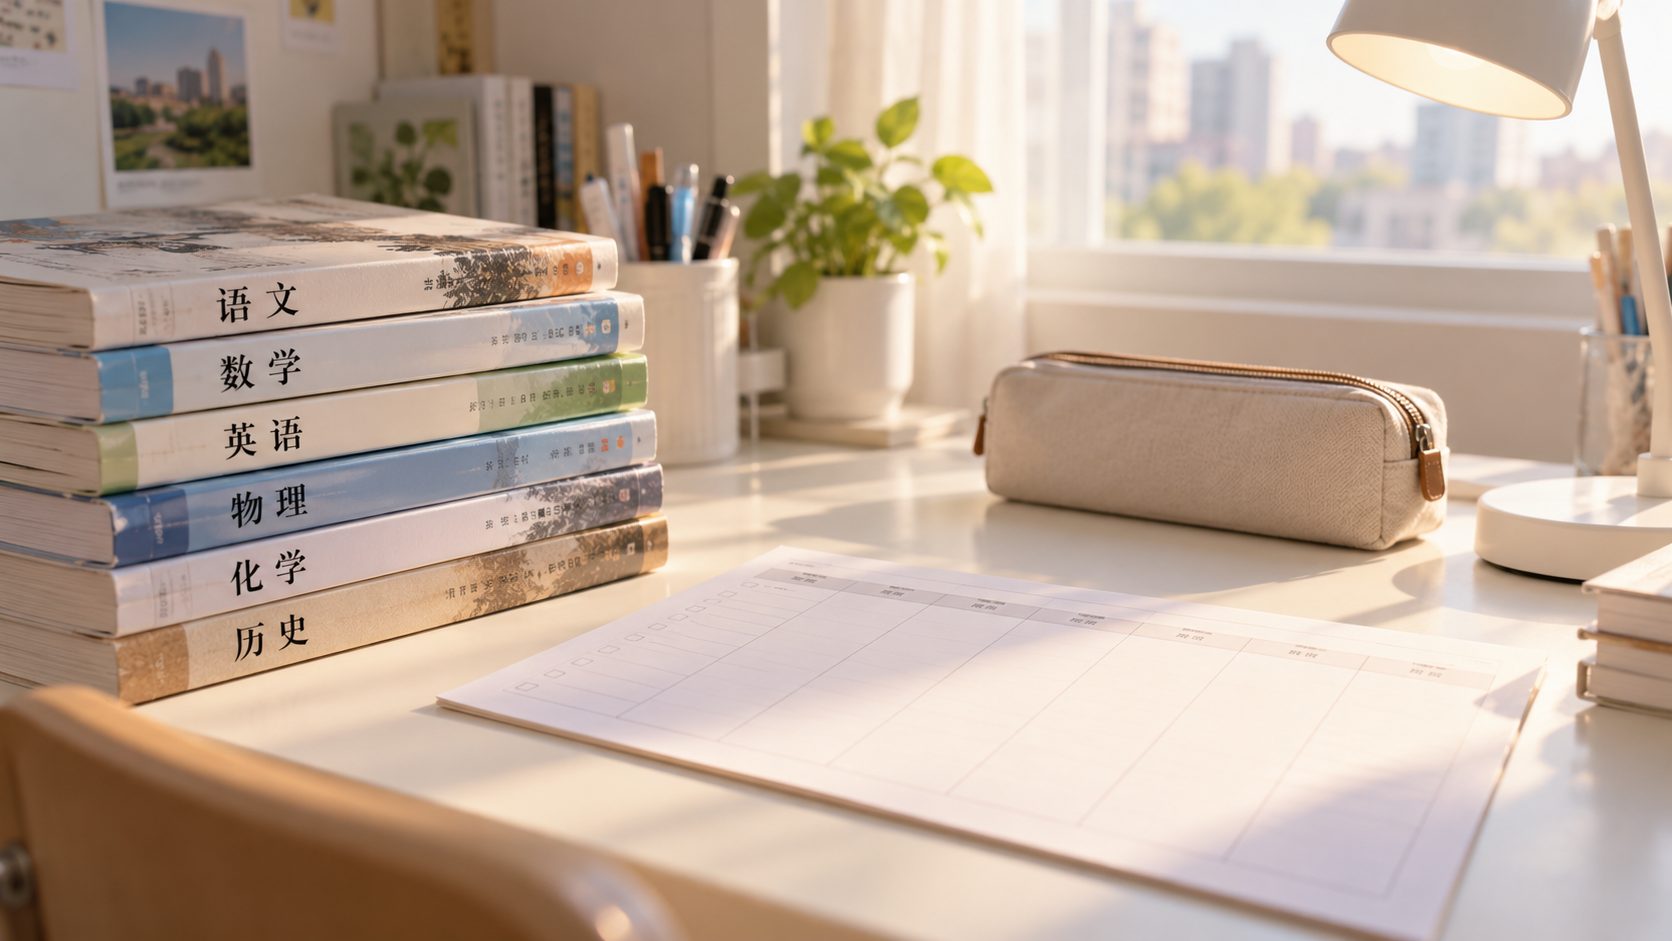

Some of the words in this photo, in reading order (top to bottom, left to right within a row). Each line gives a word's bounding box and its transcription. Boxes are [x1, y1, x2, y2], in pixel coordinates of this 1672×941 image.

[216, 281, 299, 323] 语文
[220, 348, 301, 393] 数学
[224, 416, 303, 460] 英语
[231, 483, 308, 528] 物理
[230, 549, 307, 596] 化学
[234, 614, 309, 662] 历史
